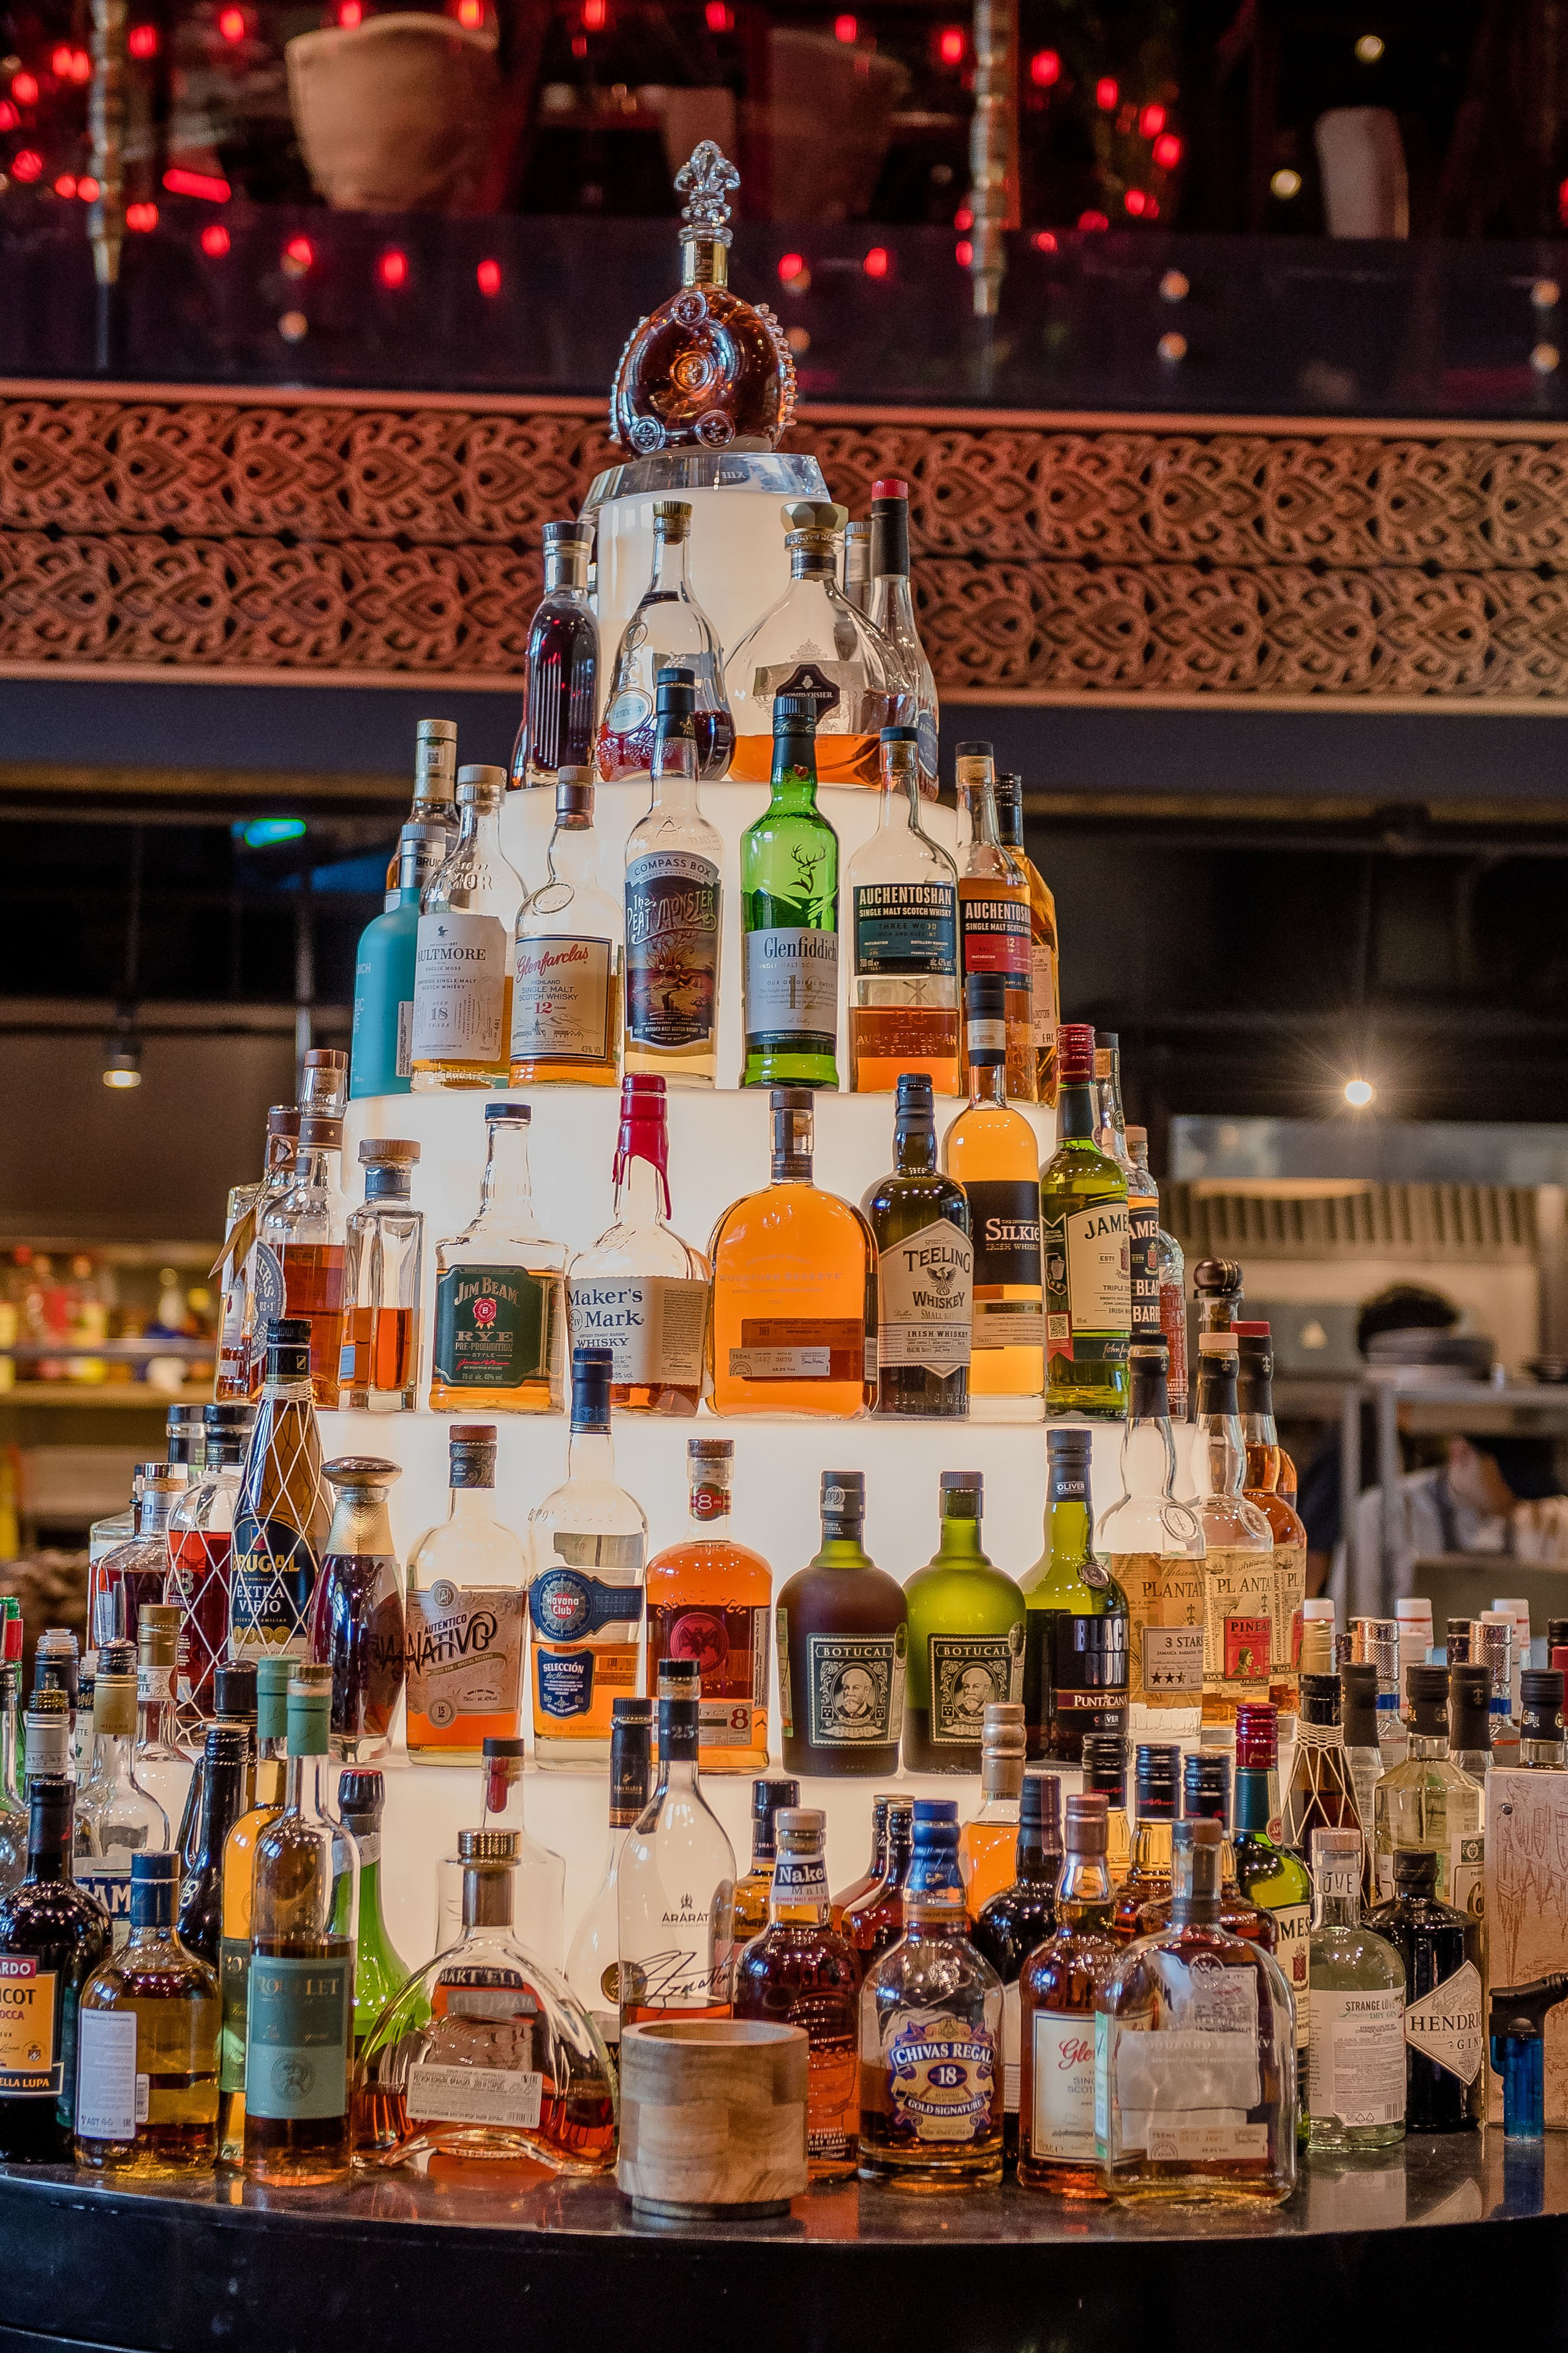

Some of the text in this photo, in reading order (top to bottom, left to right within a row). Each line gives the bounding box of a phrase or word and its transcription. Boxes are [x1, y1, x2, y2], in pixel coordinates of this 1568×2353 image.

[635, 858, 711, 878] COMPASS BOX
[643, 871, 662, 880] SCOTCH
[859, 887, 952, 906] AUCHENTOSHAN
[628, 890, 714, 946] PEAT MONSTER
[859, 908, 881, 917] SINGLE
[929, 908, 952, 917] WHISKY
[1007, 924, 1023, 933] SCOTCH
[417, 948, 486, 963] AULTMORE
[764, 936, 837, 962] Glenfiddich
[516, 943, 589, 984] Glenfarclas
[431, 1007, 448, 1020] 18
[534, 1002, 552, 1014] 12
[986, 1218, 1040, 1241] SILKIE
[903, 1247, 970, 1274] TEELING
[719, 1272, 843, 1281] WOODFORD RESERVE
[454, 1276, 519, 1306] JIM BEAM
[567, 1288, 643, 1306] Maker's
[912, 1291, 965, 1309] WHISKEY
[585, 1309, 644, 1328] Mark
[921, 1309, 943, 1320] SMALL
[455, 1331, 514, 1342] RYE
[576, 1338, 630, 1347] WHISKY
[455, 1342, 513, 1352] PRE-PROHIBITION
[698, 1495, 712, 1510] 8
[232, 1554, 300, 1573] BRUGAL
[236, 1586, 285, 1598] EXTRA
[548, 1594, 579, 1606] Havana
[239, 1600, 281, 1616] VIEJO
[552, 1605, 571, 1615] Club
[405, 1611, 498, 1676] NATIVO
[1164, 1636, 1204, 1648] 3 STARS
[823, 1646, 888, 1657] BOTUCAL
[944, 1645, 1006, 1655] BOTUCAL
[458, 1659, 475, 1668] SPECIAL
[475, 1654, 493, 1662] RESERVE
[543, 1662, 584, 1674] SELECCIÓN
[437, 1706, 445, 1714] 15
[731, 1708, 748, 1730] 8
[671, 1725, 695, 1739] 25
[1346, 2001, 1380, 2011] STRANGE
[1457, 2036, 1480, 2050] GIN
[896, 2043, 992, 2064] CHIVAS REGAL
[1058, 2038, 1095, 2070] Gle
[938, 2066, 957, 2085] 18
[23, 2078, 50, 2088] LUPA
[908, 2098, 983, 2115] GOLD SIGNATURE
